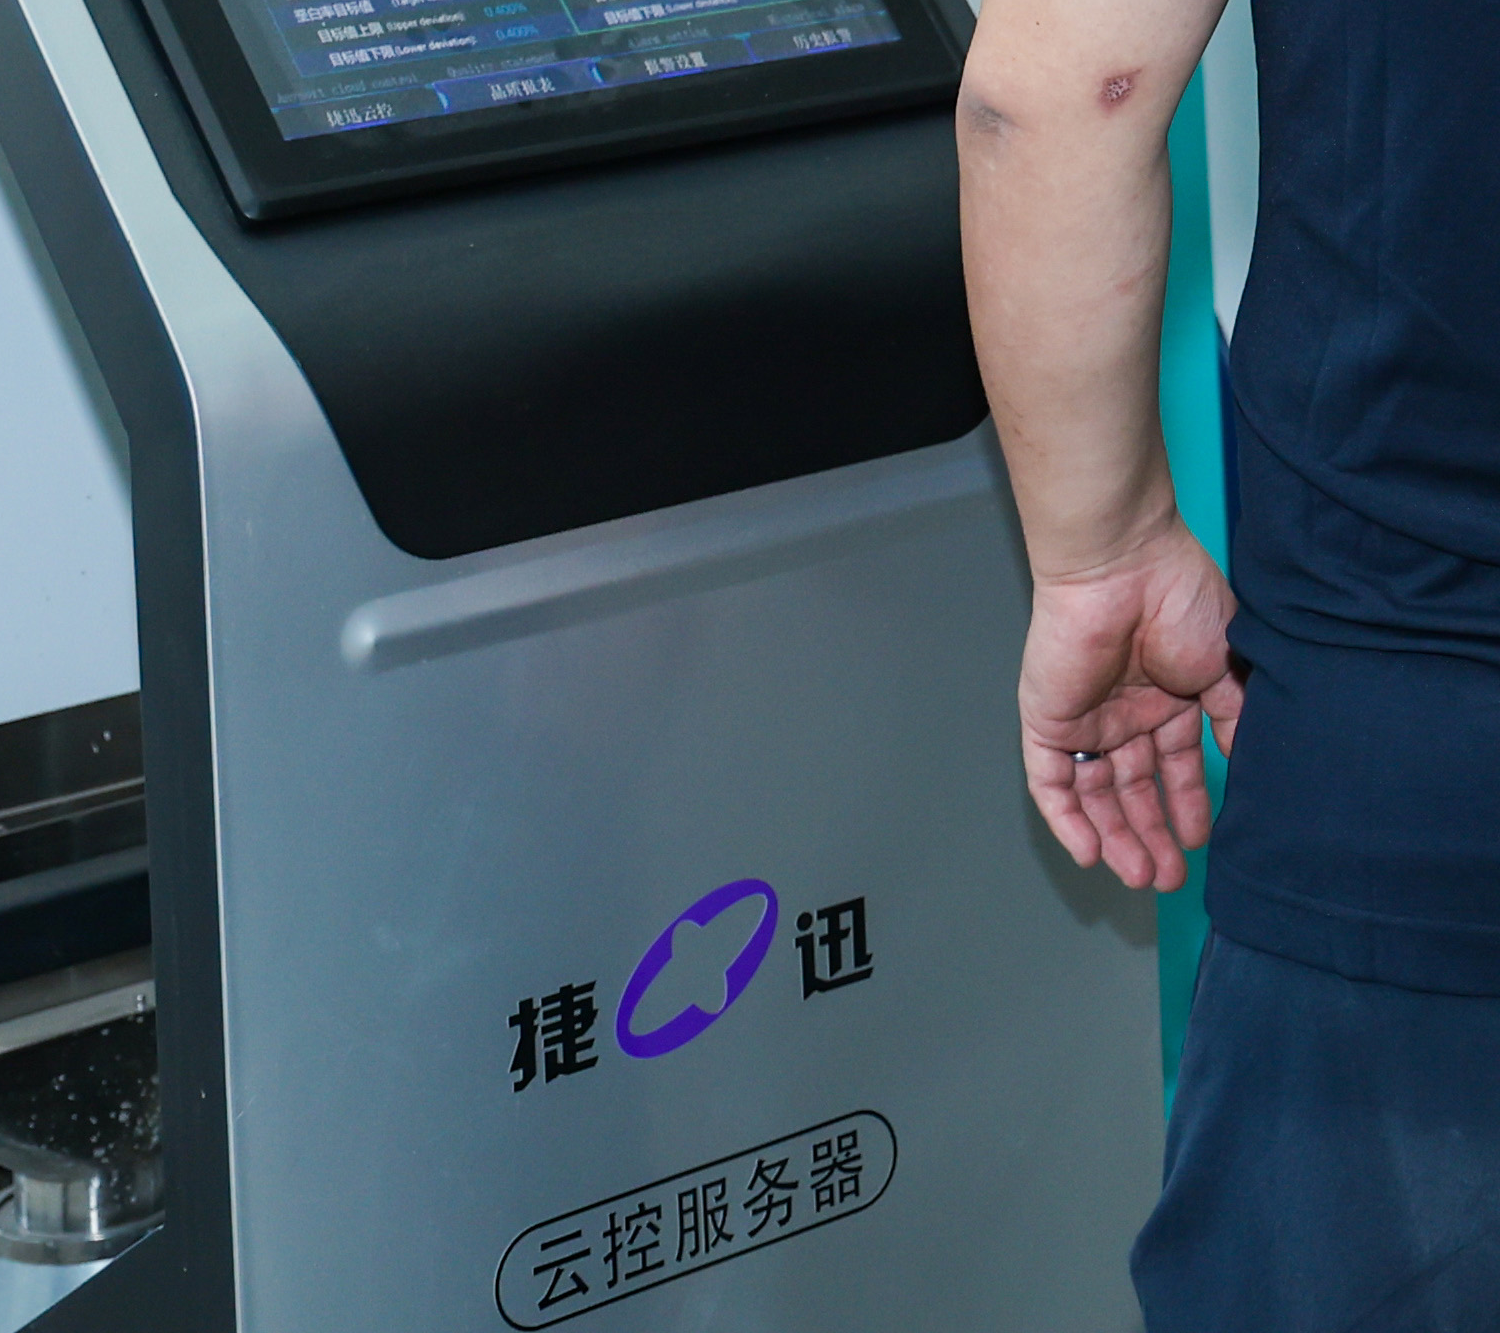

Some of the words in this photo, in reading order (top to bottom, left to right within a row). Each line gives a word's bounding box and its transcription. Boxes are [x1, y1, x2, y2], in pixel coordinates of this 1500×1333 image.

[317, 21, 384, 43] 目标值上限
[329, 44, 396, 67] 目标值下限
[396, 40, 427, 56] (Lower
[644, 51, 708, 76] 报警设置
[326, 102, 396, 128] 捷迅云控
[506, 980, 600, 1093] 捷
[793, 895, 874, 1001] 迅
[532, 1129, 864, 1312] 云控服务器
